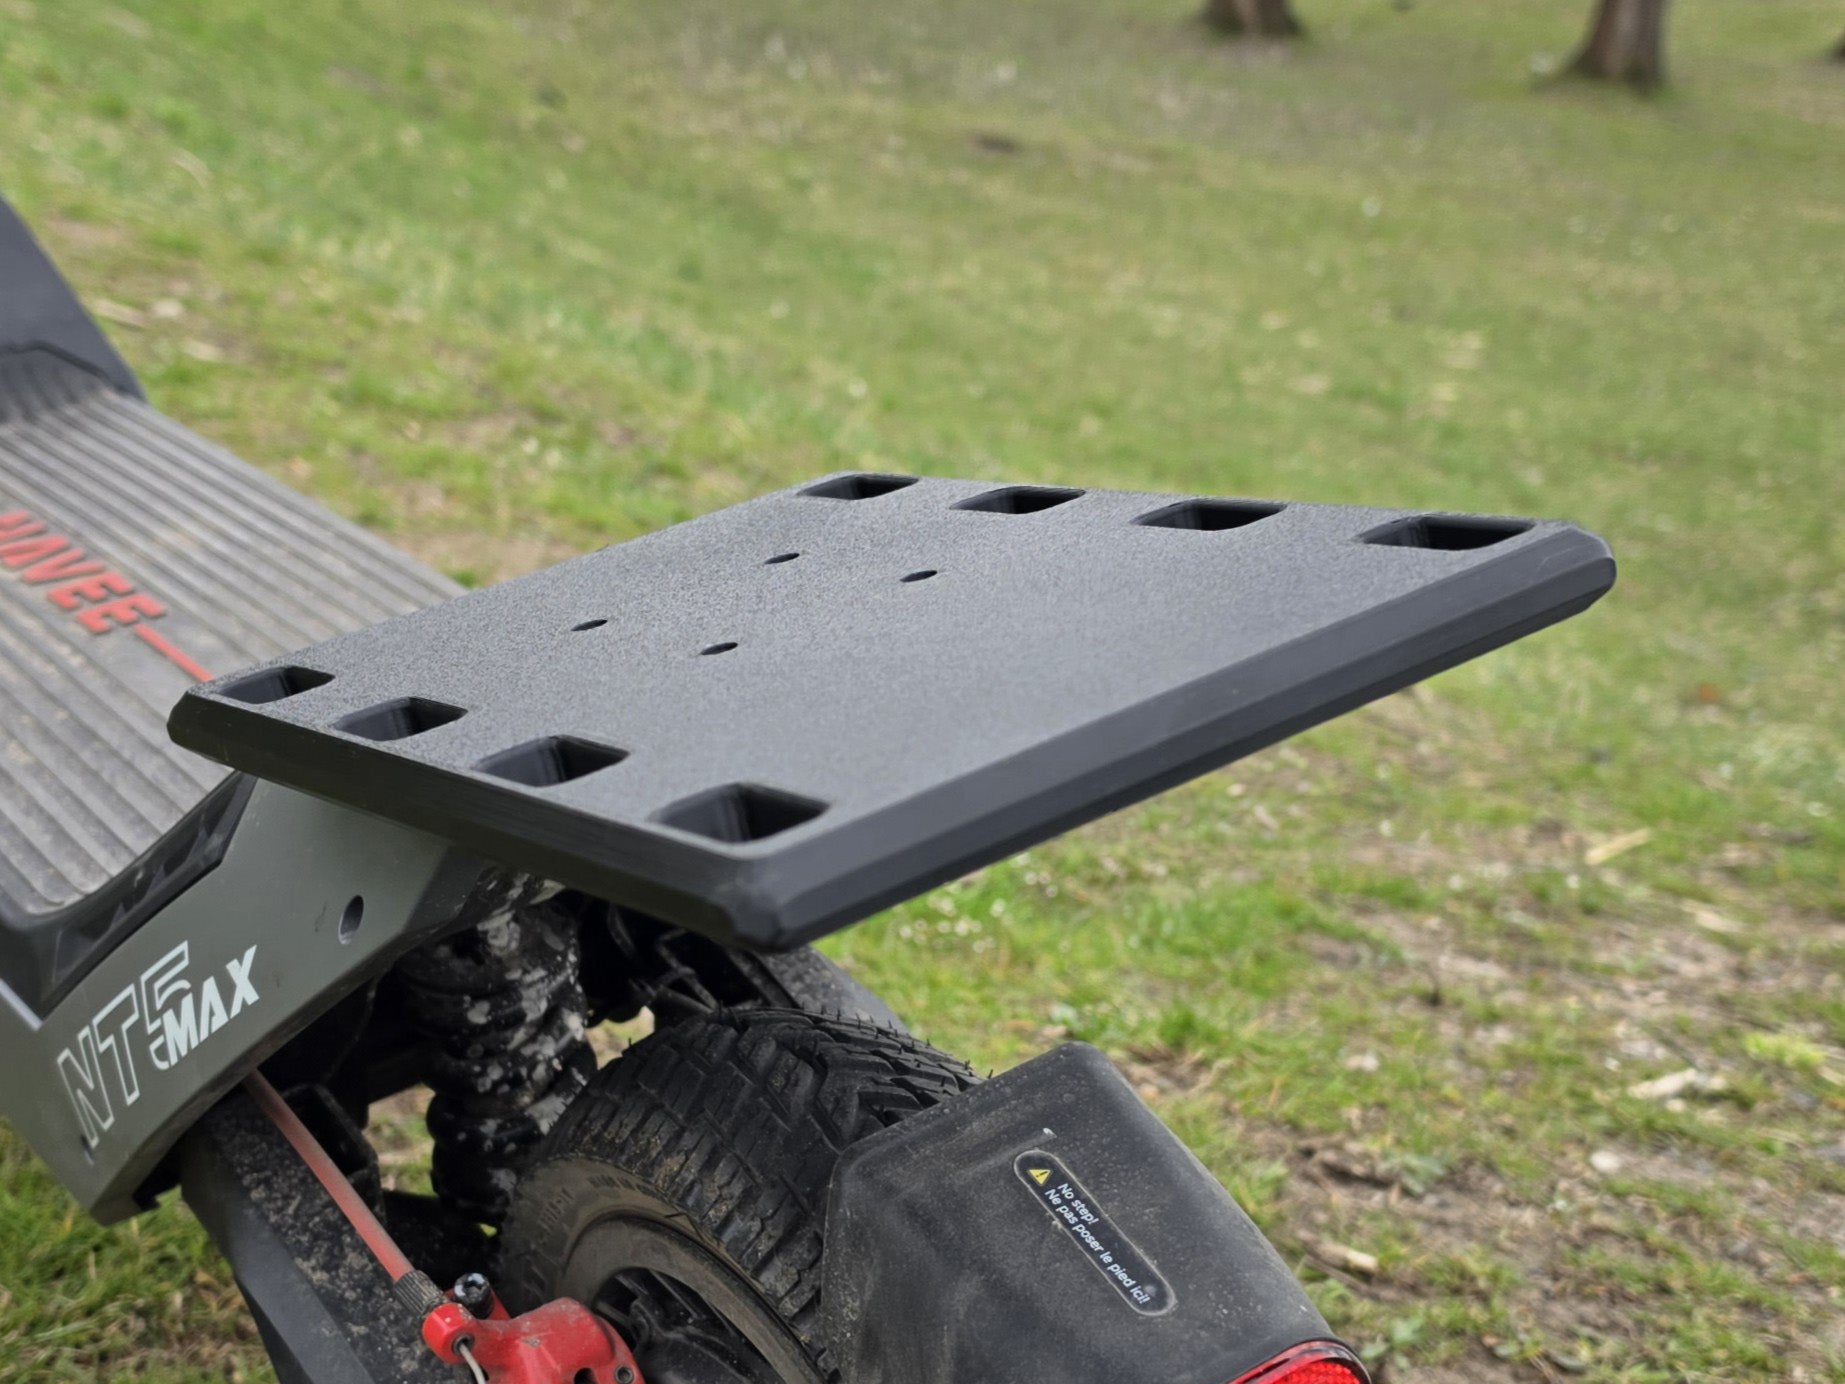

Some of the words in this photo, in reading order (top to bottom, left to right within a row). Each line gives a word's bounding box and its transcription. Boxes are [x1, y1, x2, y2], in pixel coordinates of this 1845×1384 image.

[162, 944, 260, 1068] MAX
[1044, 1188, 1062, 1205] Ne
[1055, 1205, 1079, 1226] pas
[1072, 1223, 1105, 1252] poser
[1099, 1251, 1114, 1265] le
[1107, 1264, 1136, 1288] pied
[1057, 1182, 1075, 1200] No
[1071, 1199, 1100, 1226] step!
